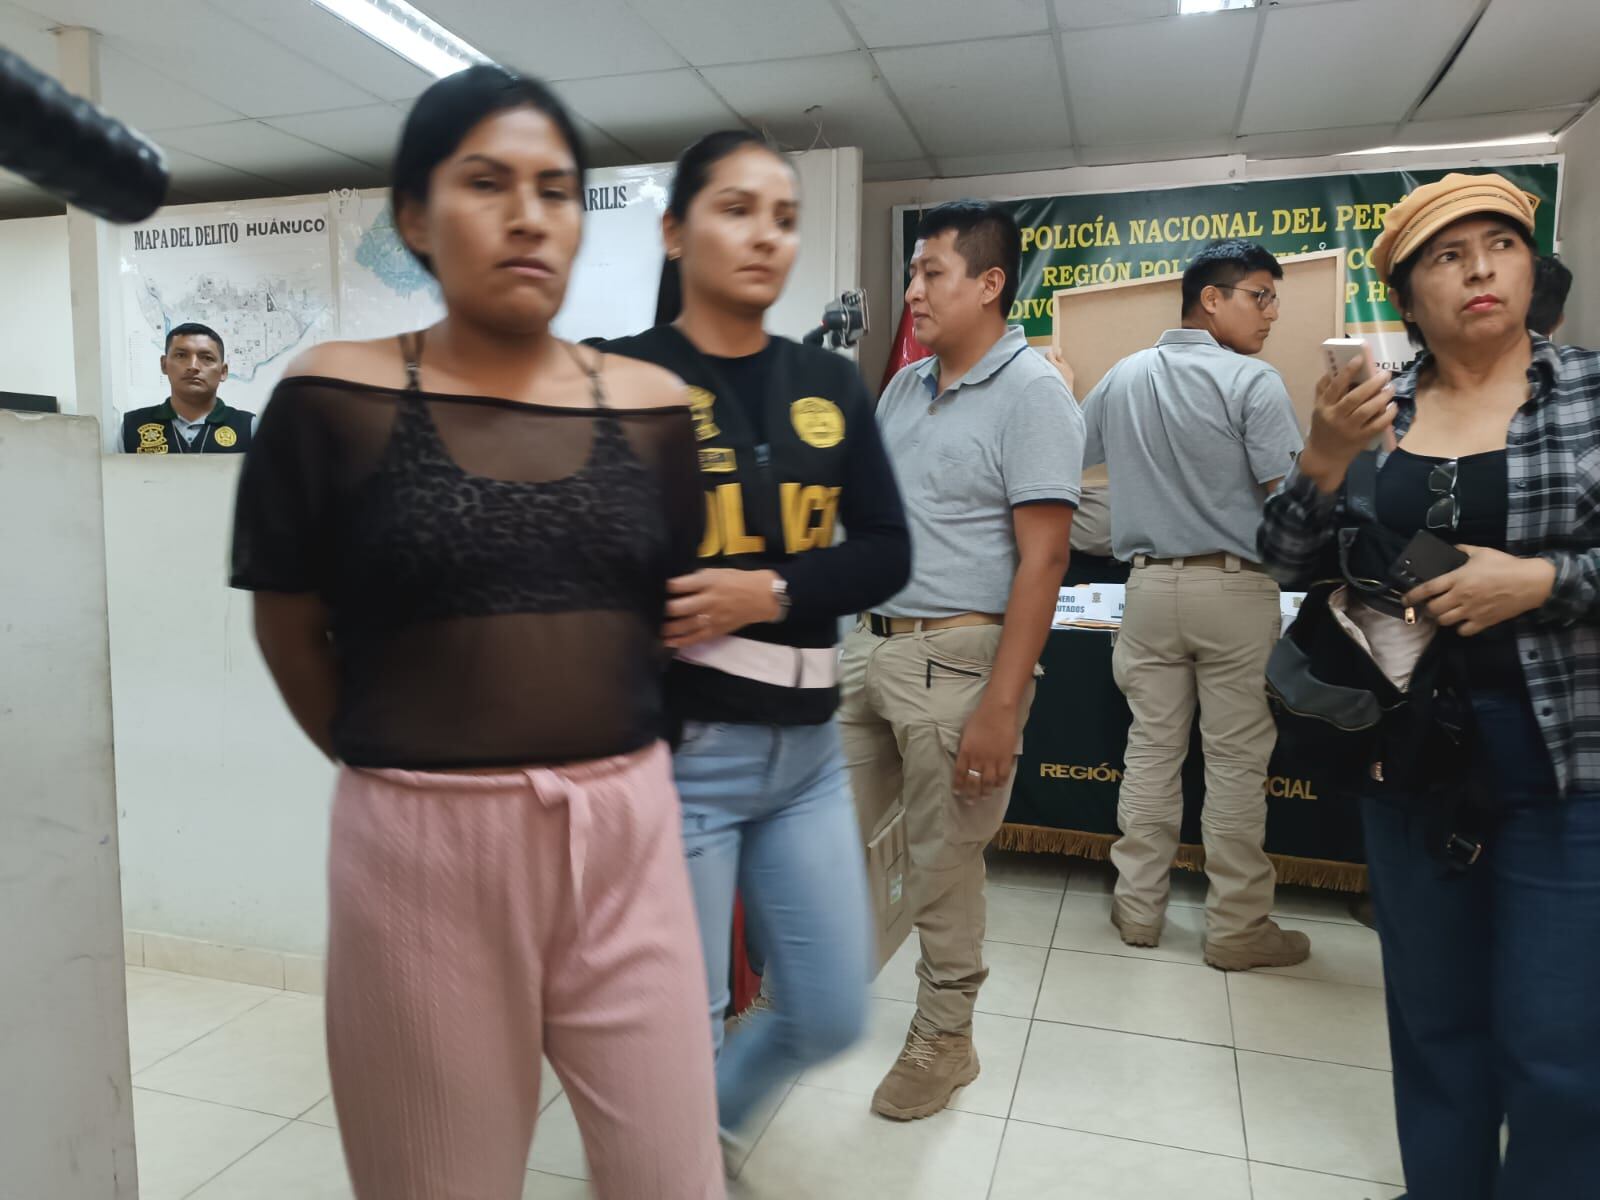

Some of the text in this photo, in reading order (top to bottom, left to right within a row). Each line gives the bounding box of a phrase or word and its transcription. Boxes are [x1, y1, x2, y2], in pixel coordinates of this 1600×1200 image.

[584, 186, 627, 211] RILIS
[134, 218, 325, 250] MAPA DEL DELITO HUÁNUCO
[1020, 197, 1402, 251] POLICÍA NACIONAL DEL PER
[1042, 258, 1131, 287] REGIÓN
[1140, 258, 1190, 278] POL
[1055, 605, 1085, 613] UTADOS
[1040, 762, 1318, 800] REGIÓN ICIAL
